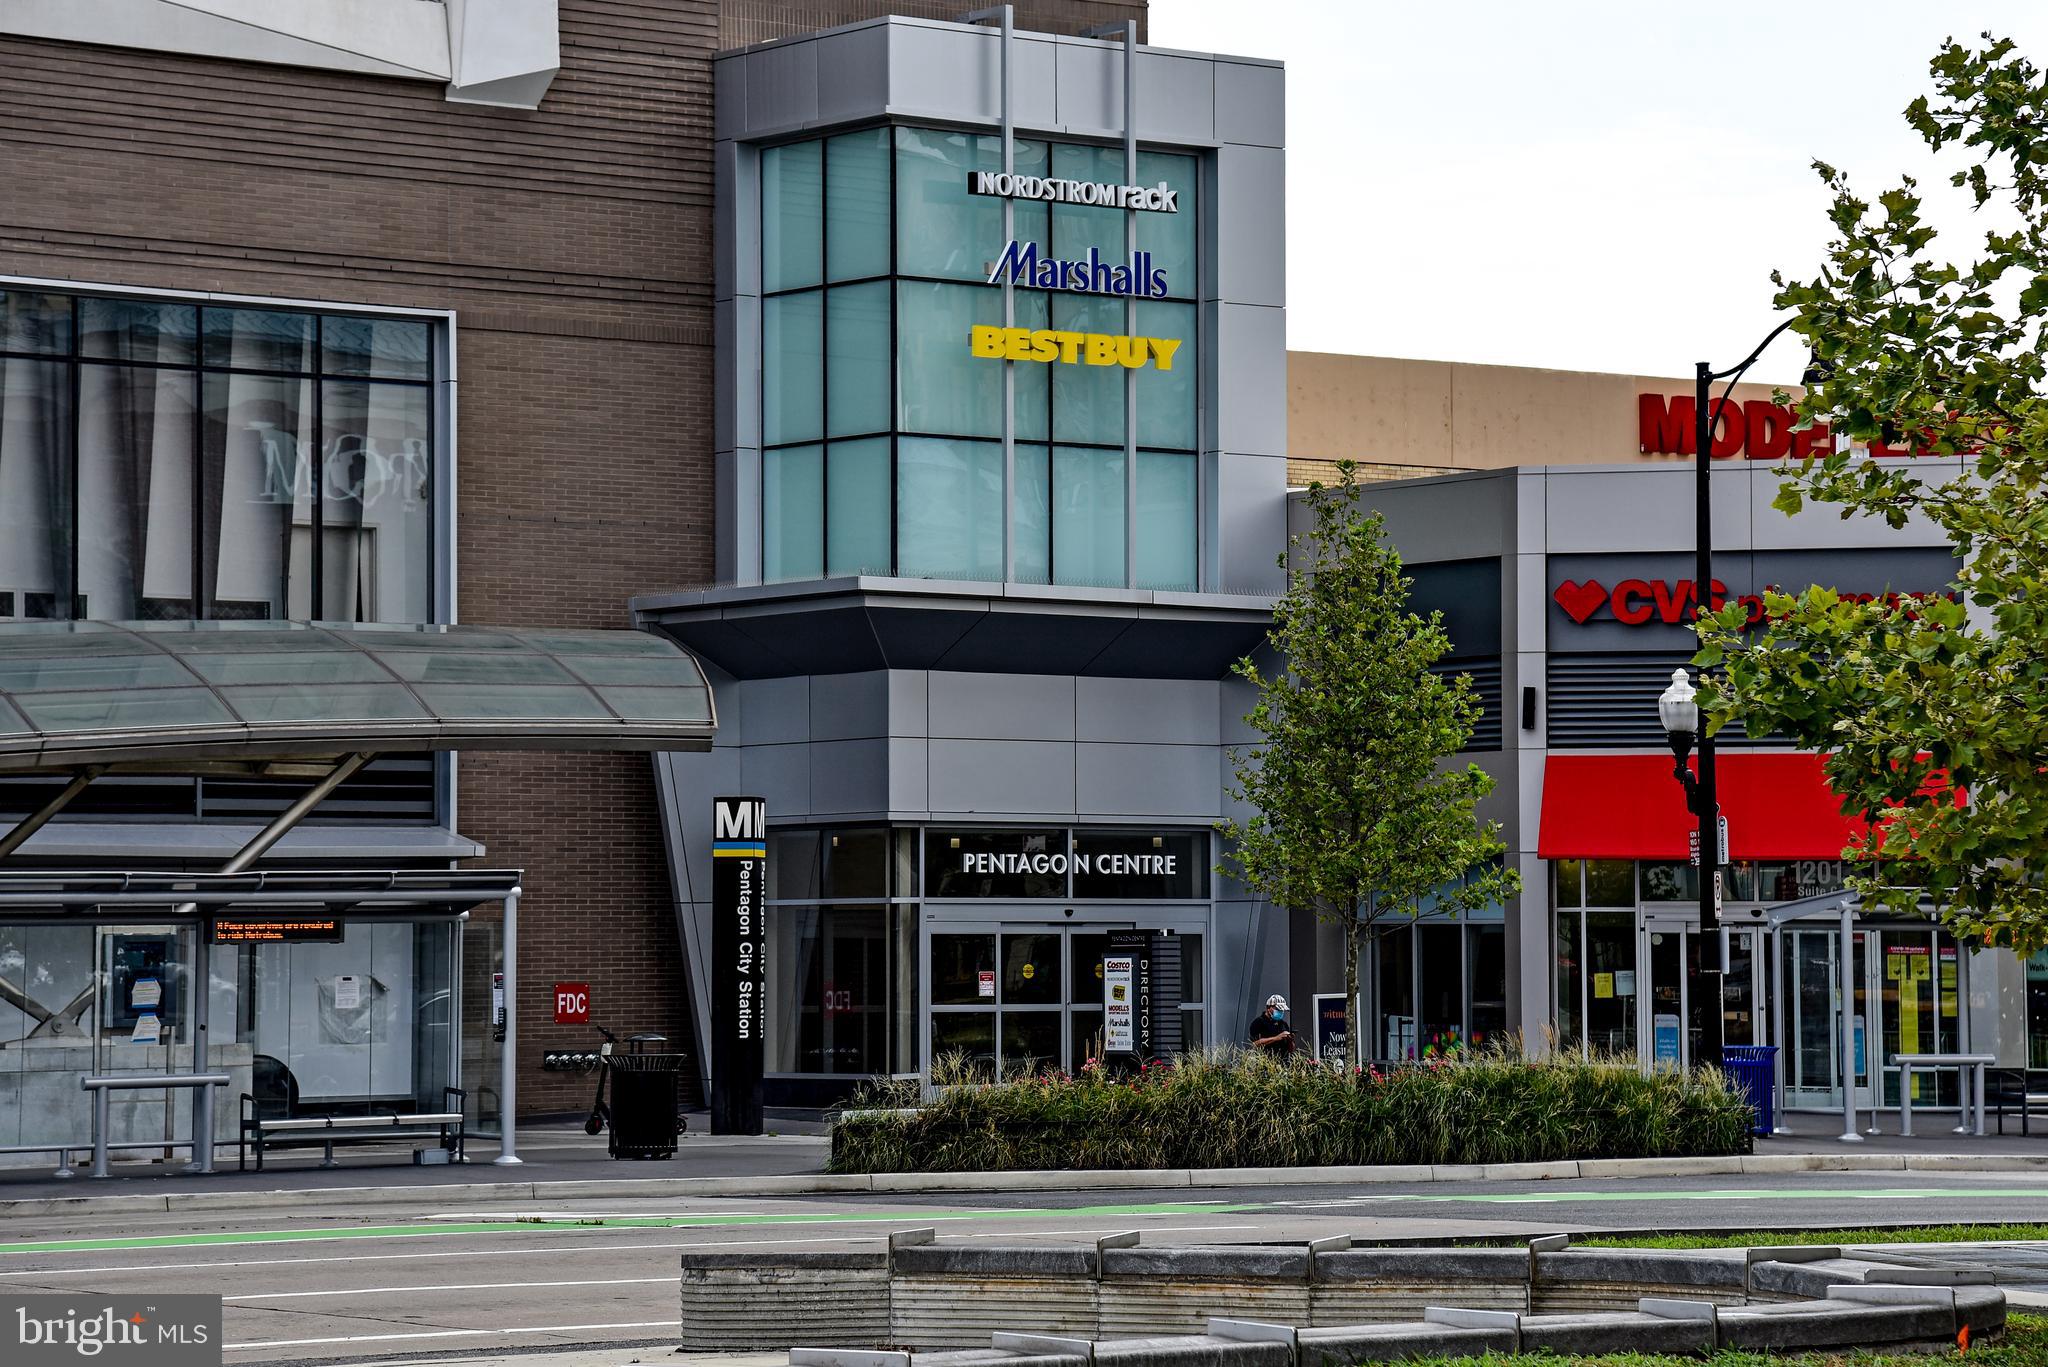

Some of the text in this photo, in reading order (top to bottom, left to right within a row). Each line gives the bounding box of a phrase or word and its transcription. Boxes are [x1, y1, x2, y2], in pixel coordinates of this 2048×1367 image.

[977, 172, 1178, 212] NORDSTROM rack
[988, 240, 1168, 297] Marshalls
[972, 325, 1182, 371] BEST BUY
[1611, 579, 1728, 624] CVS
[715, 801, 753, 839] M
[963, 853, 1176, 875] PENTAGON CENTRE
[1790, 861, 1842, 885] 1201
[1797, 886, 1827, 897] Suite
[737, 861, 753, 1040] Pentagon City Station
[557, 993, 587, 1014] FDC
[1140, 959, 1149, 1048] DIRECTORY
[1323, 1044, 1346, 1056] Leasi
